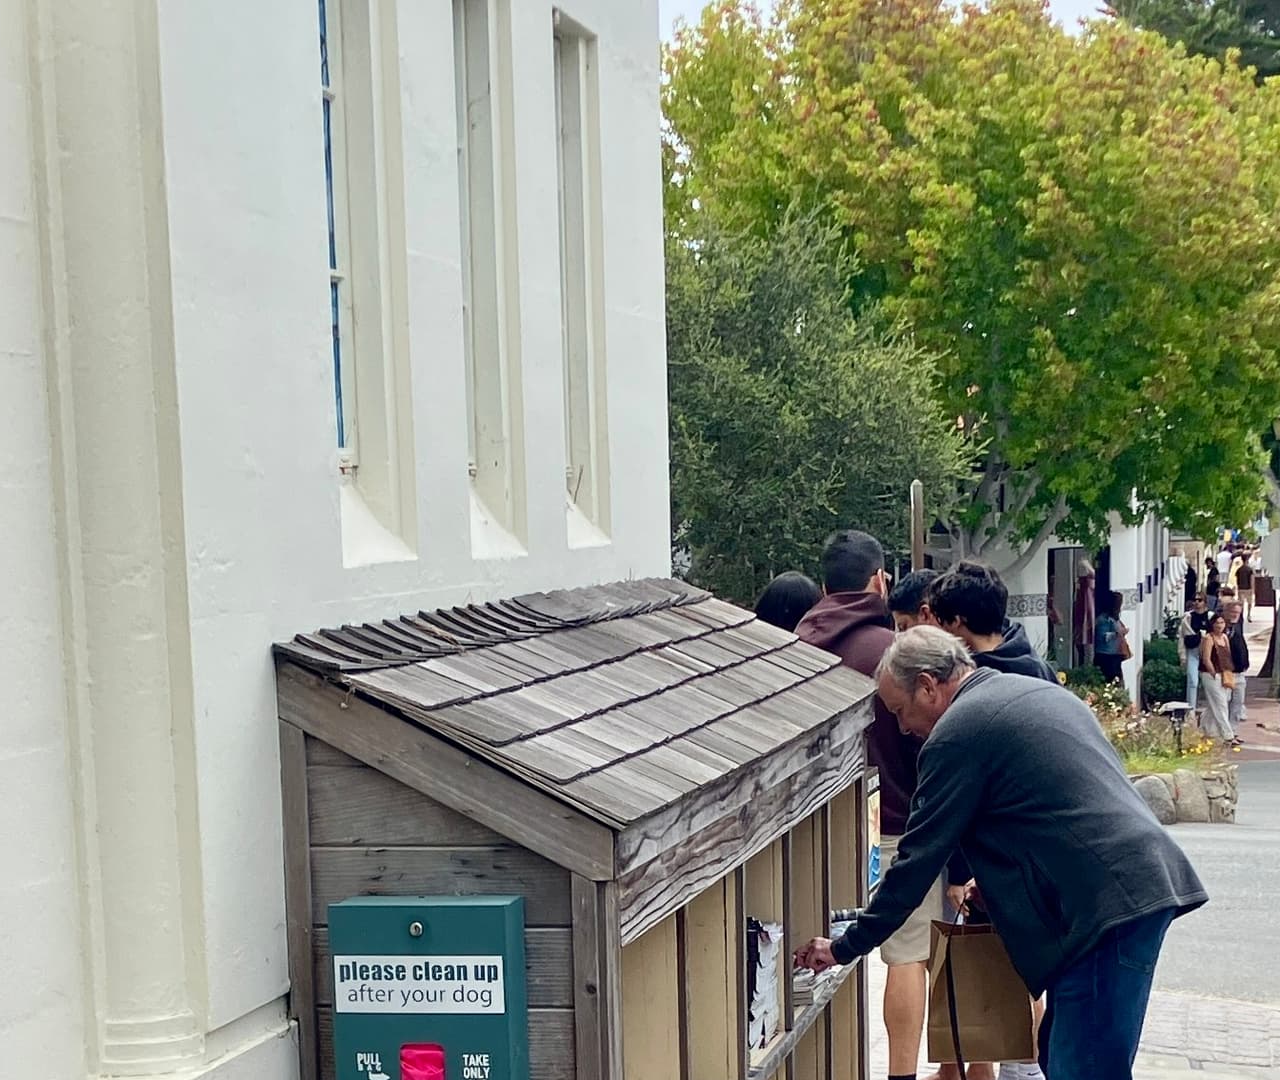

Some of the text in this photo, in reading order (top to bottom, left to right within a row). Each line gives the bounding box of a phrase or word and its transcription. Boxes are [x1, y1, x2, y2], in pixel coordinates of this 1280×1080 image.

[339, 961, 499, 983] please clean up
[348, 984, 493, 1008] after your dog
[356, 1052, 381, 1065] PULL
[462, 1054, 490, 1067] TAKE
[463, 1067, 491, 1079] ONLY
